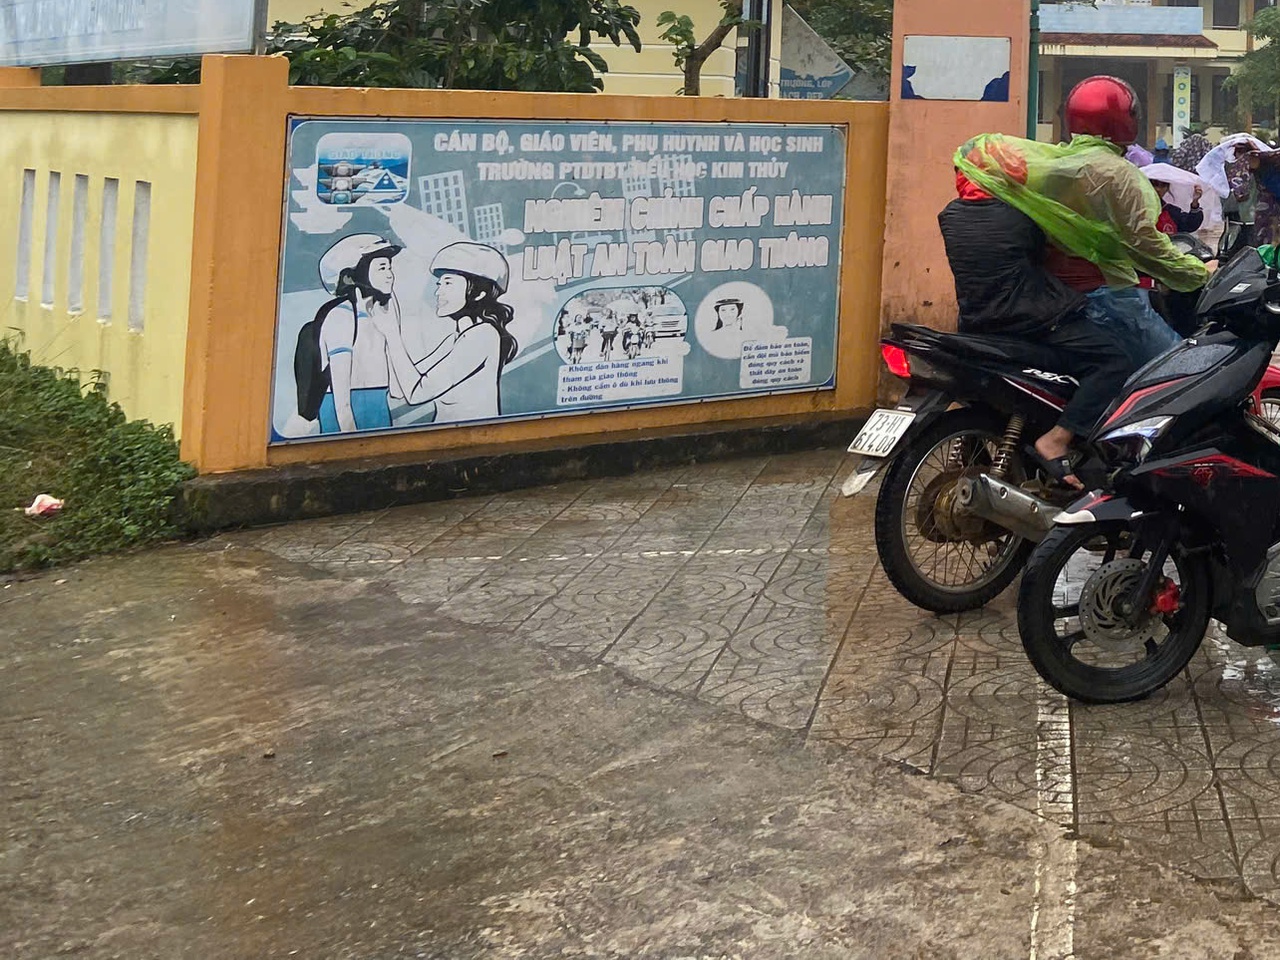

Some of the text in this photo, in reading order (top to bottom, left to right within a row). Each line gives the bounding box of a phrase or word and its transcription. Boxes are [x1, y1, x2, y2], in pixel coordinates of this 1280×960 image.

[433, 130, 824, 157] CÁN BỘ, GIÁO VIÊN, PHỤ HUYNH VÀ HỌC SINH
[477, 158, 555, 182] TRƯỜNG
[711, 161, 744, 179] KIM
[773, 189, 833, 227] HÀNH
[522, 231, 829, 285] LUẬT AN TOÀN GIAO THÔNG
[568, 365, 593, 373] Không
[584, 374, 597, 383] gia
[598, 373, 615, 382] giao
[567, 385, 592, 393] Không
[630, 379, 643, 387] khi
[869, 413, 907, 435] 73-H1
